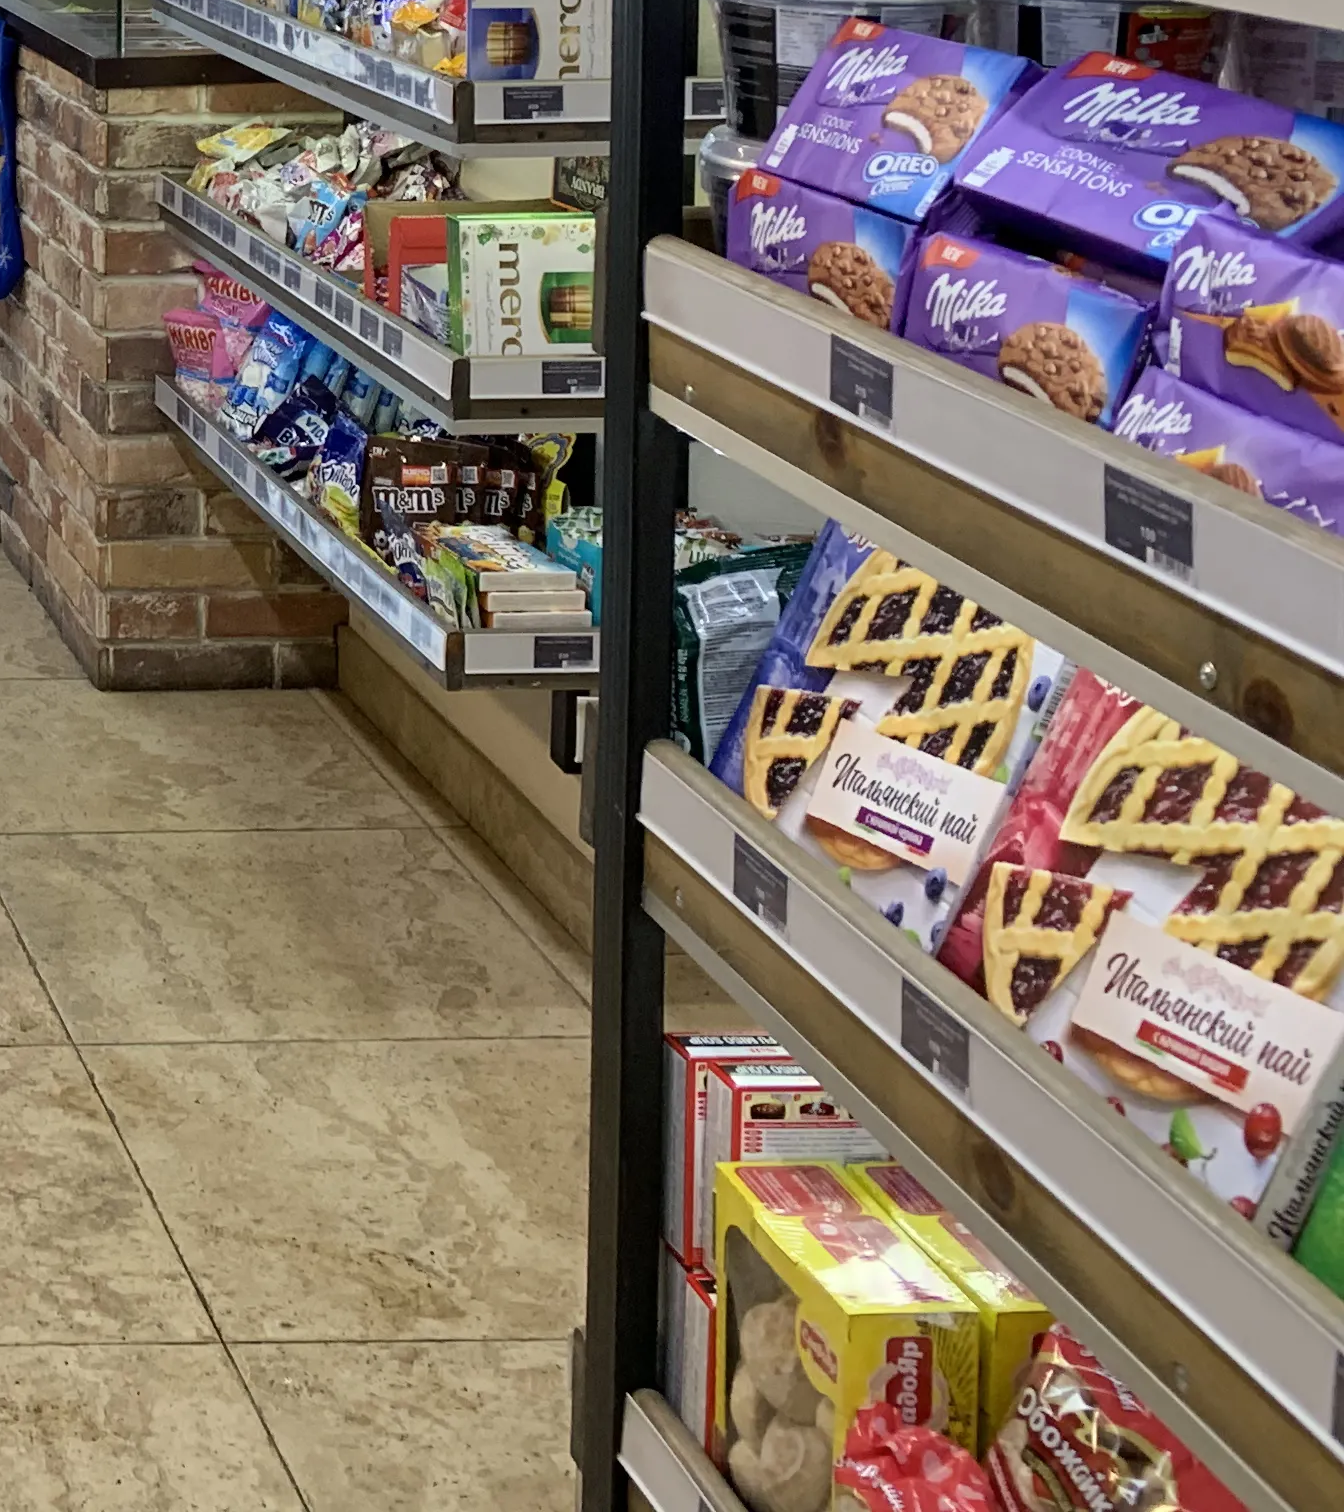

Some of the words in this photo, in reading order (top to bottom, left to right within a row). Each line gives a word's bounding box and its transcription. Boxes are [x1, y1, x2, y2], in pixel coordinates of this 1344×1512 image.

[853, 21, 876, 38] NEW
[824, 43, 910, 91] Milka
[1102, 60, 1139, 76] NEW
[1062, 82, 1202, 126] Milka
[797, 121, 863, 155] SENSATIONS
[1061, 144, 1116, 177] COOKIE
[751, 175, 769, 191] NEW
[866, 153, 939, 177] OREO
[1016, 149, 1134, 199] SENSATIONS
[750, 201, 808, 256] Milka
[940, 243, 966, 262] NEW
[1174, 244, 1258, 298] Milka
[497, 242, 523, 356] merc
[925, 273, 1009, 333] Milka
[1114, 392, 1194, 439] Milka
[832, 752, 940, 826] Итальянский
[939, 804, 979, 846] пай
[1103, 951, 1256, 1058] Итальянский
[1256, 1040, 1314, 1087] пай
